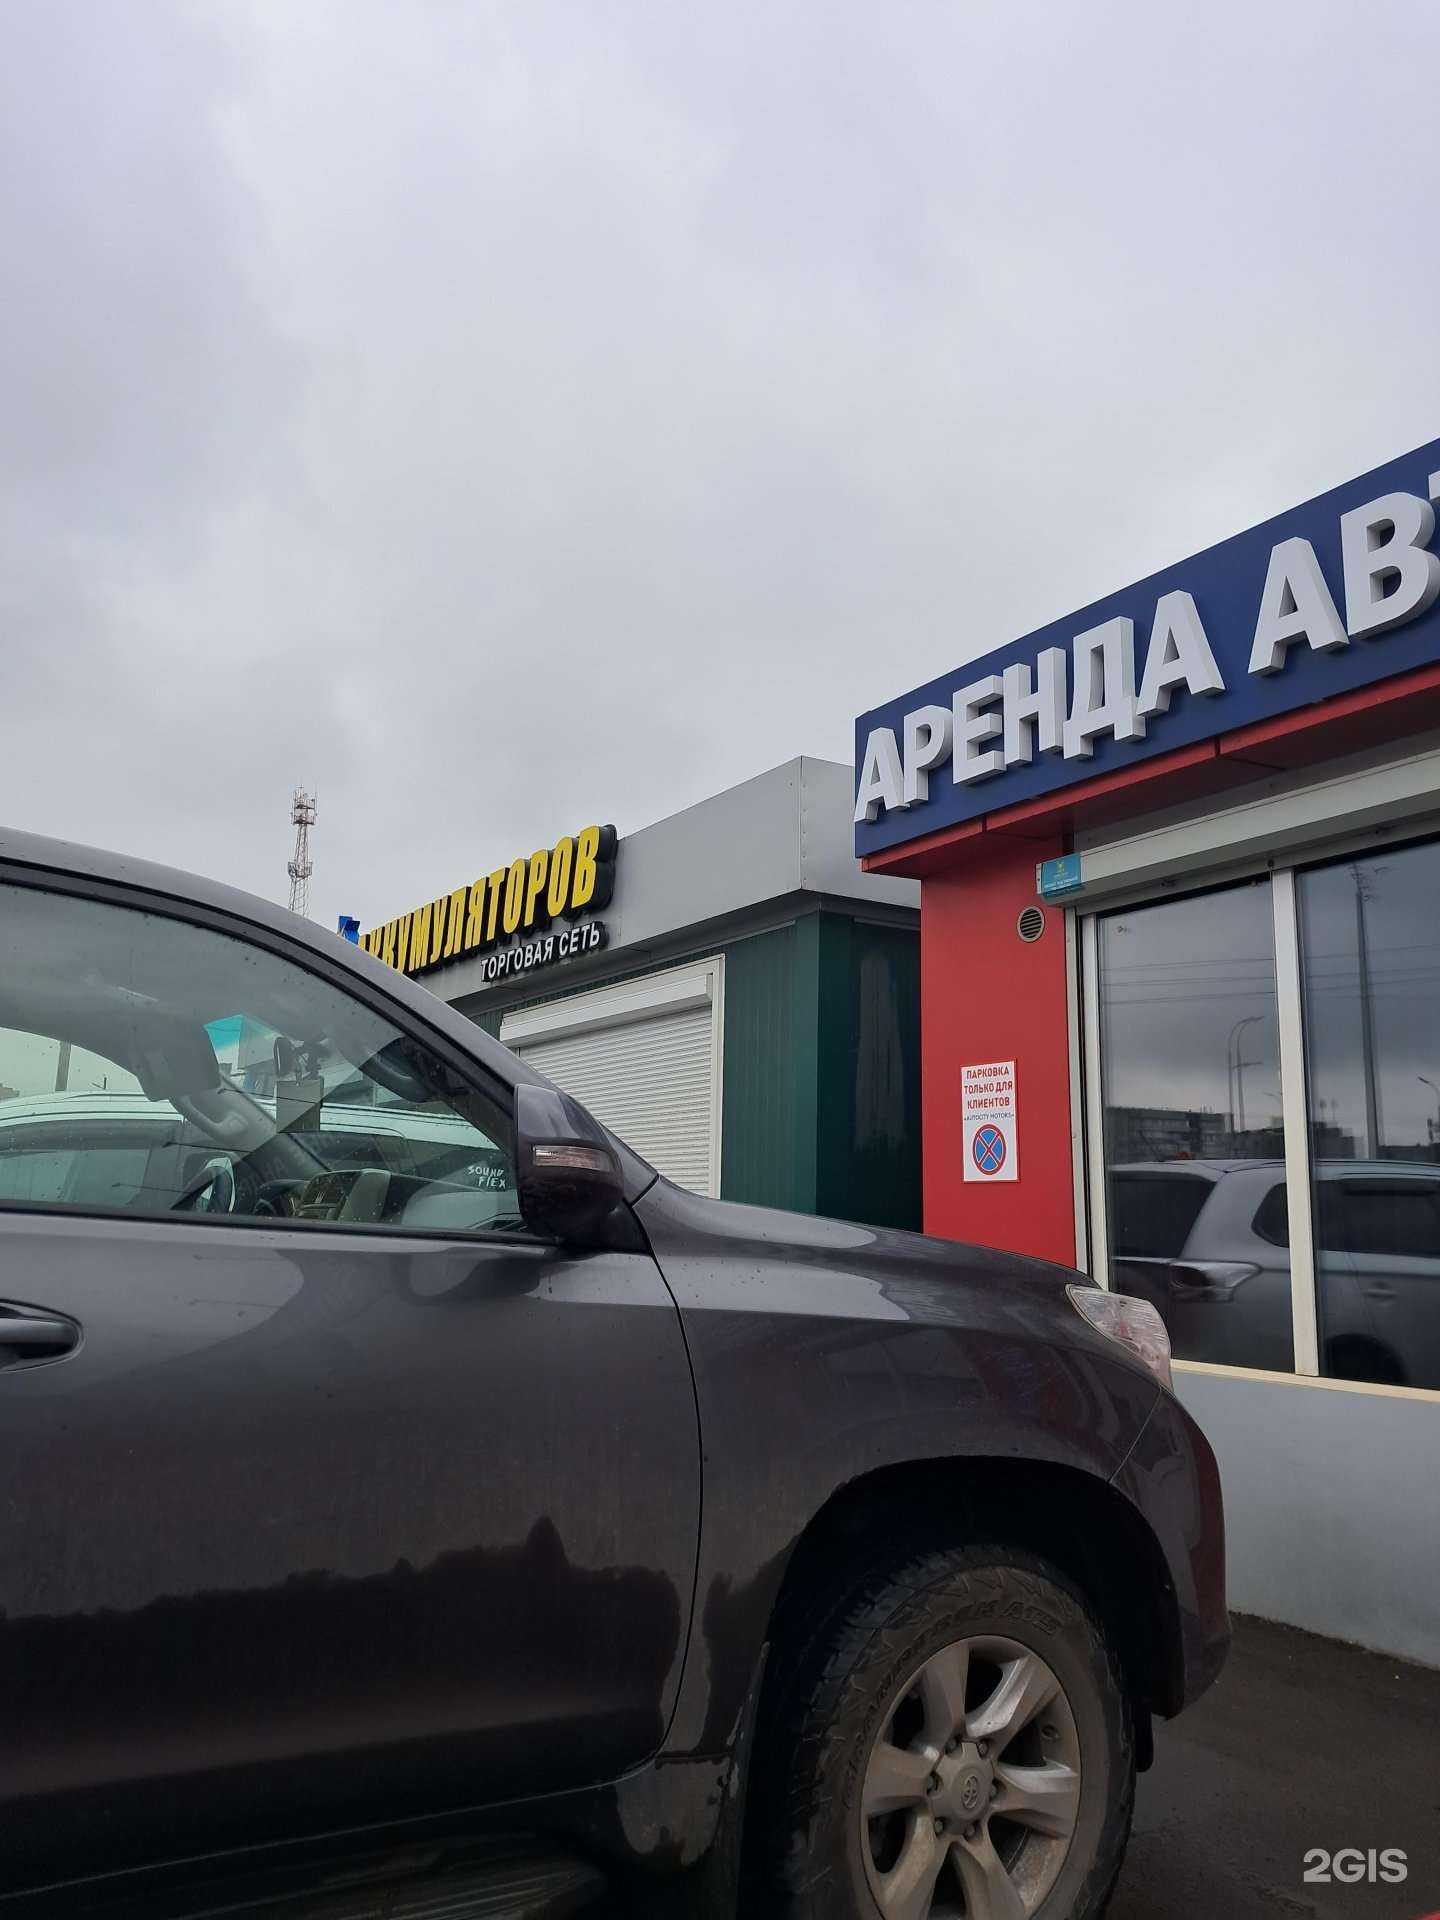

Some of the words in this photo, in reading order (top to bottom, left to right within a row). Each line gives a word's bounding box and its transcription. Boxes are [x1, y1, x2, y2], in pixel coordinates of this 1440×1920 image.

[854, 589, 1226, 824] АРЕНДА
[1248, 471, 1440, 677] АВ
[359, 825, 614, 973] КУМУЛЯТОРОВ
[480, 939, 554, 982] ТОРГОВАЯ
[558, 921, 601, 957] СЕТЬ
[964, 1083, 994, 1095] ТОЛЬКО
[995, 1080, 1013, 1094] ДЛЯ
[966, 1066, 1009, 1079] ПАРКОВКА
[967, 1096, 1010, 1110] КЛИЕНТОВ
